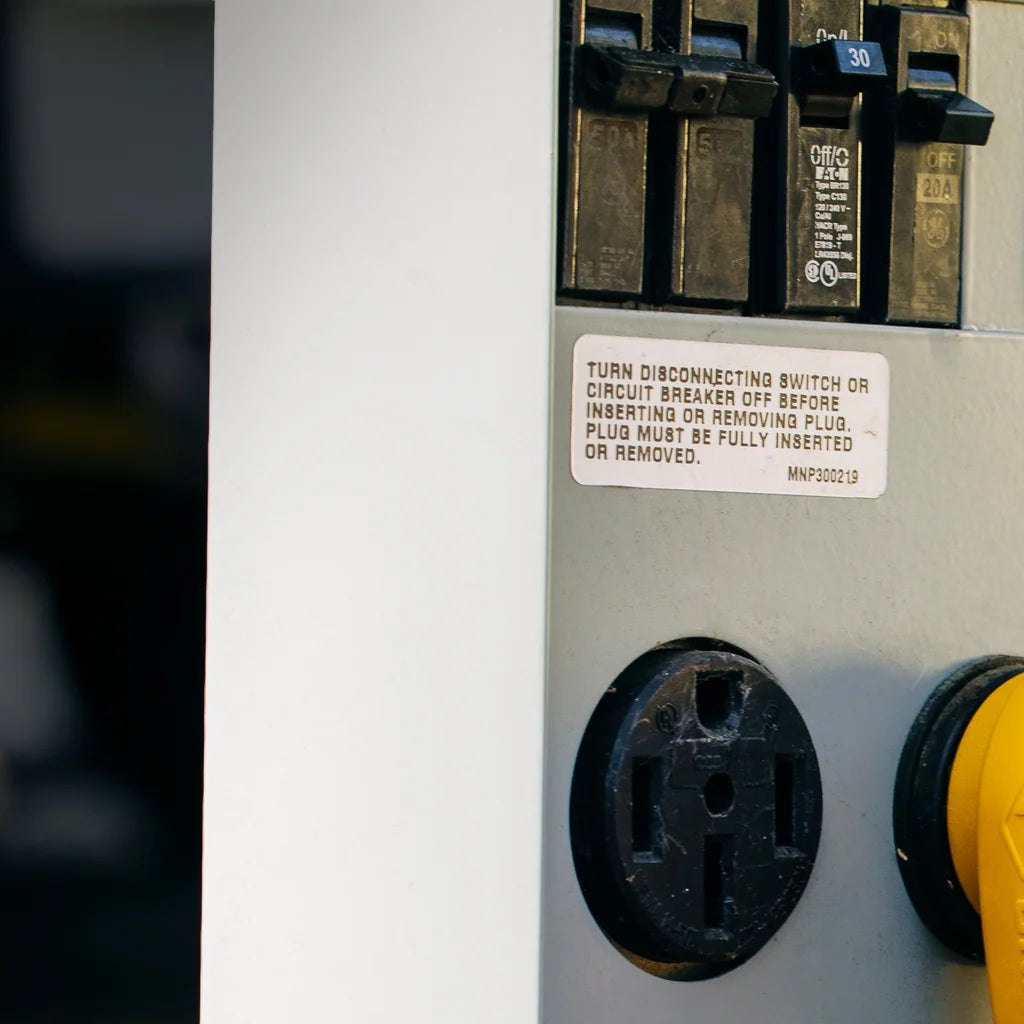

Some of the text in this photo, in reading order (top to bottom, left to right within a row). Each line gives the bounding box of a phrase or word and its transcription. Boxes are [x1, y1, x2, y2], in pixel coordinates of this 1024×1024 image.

[848, 47, 871, 68] 30
[927, 151, 957, 168] OFF
[815, 191, 830, 201] Type
[922, 178, 952, 199] 20A
[833, 222, 848, 232] Type
[587, 361, 869, 394] TURN DISCONNECTING SWITCH OR
[586, 382, 840, 412] CIRCUIT BREAKER OFF BEFORE
[586, 402, 852, 432] INSERTING OR REMOVING PLUG.
[586, 422, 853, 451] PLUG MUST BE FULLY INSERTED
[585, 443, 701, 464] OR REMOVED.
[788, 465, 859, 484] MNP300219
